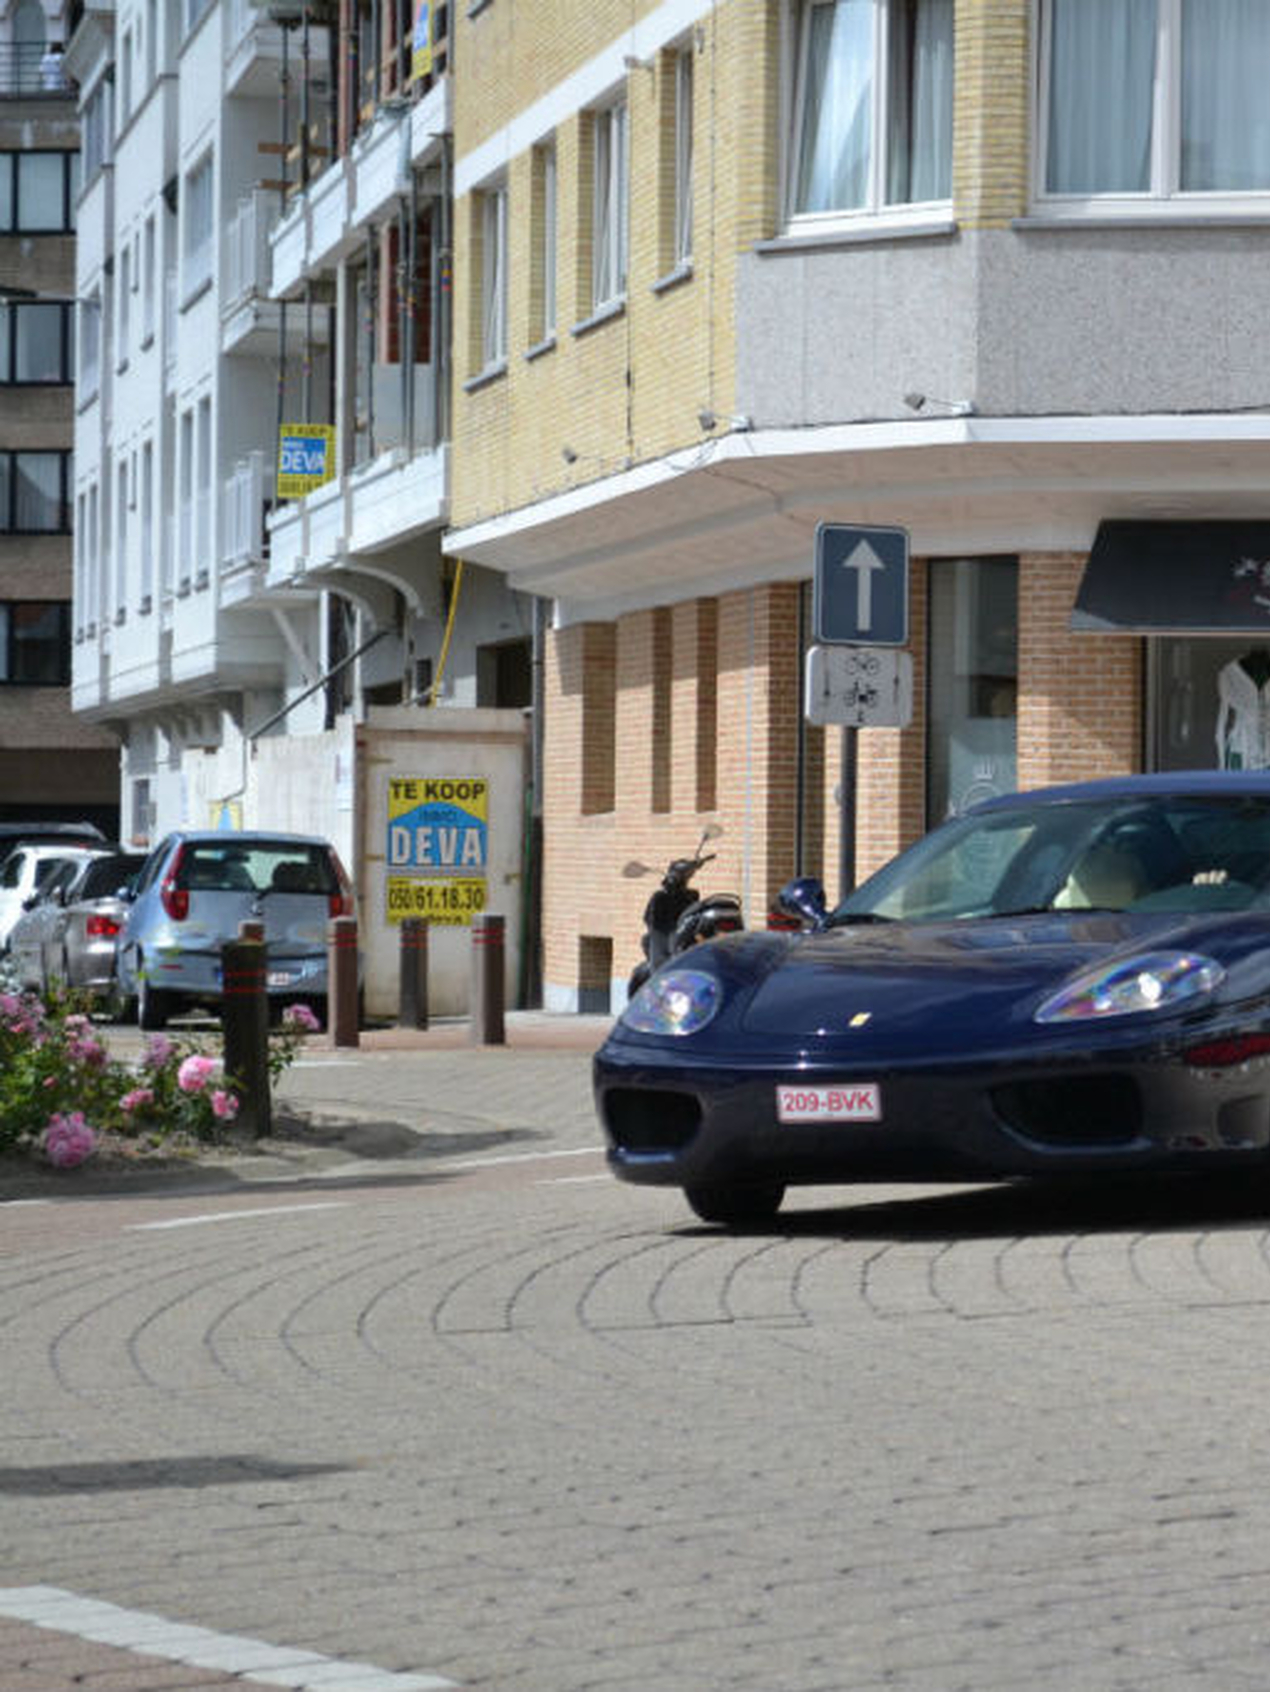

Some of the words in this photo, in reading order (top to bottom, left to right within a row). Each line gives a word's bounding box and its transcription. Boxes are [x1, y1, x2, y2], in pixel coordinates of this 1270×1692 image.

[391, 783, 417, 799] TE
[425, 783, 485, 799] KOOP
[391, 826, 481, 865] DEVA
[783, 1091, 874, 1112] 209-BVK
